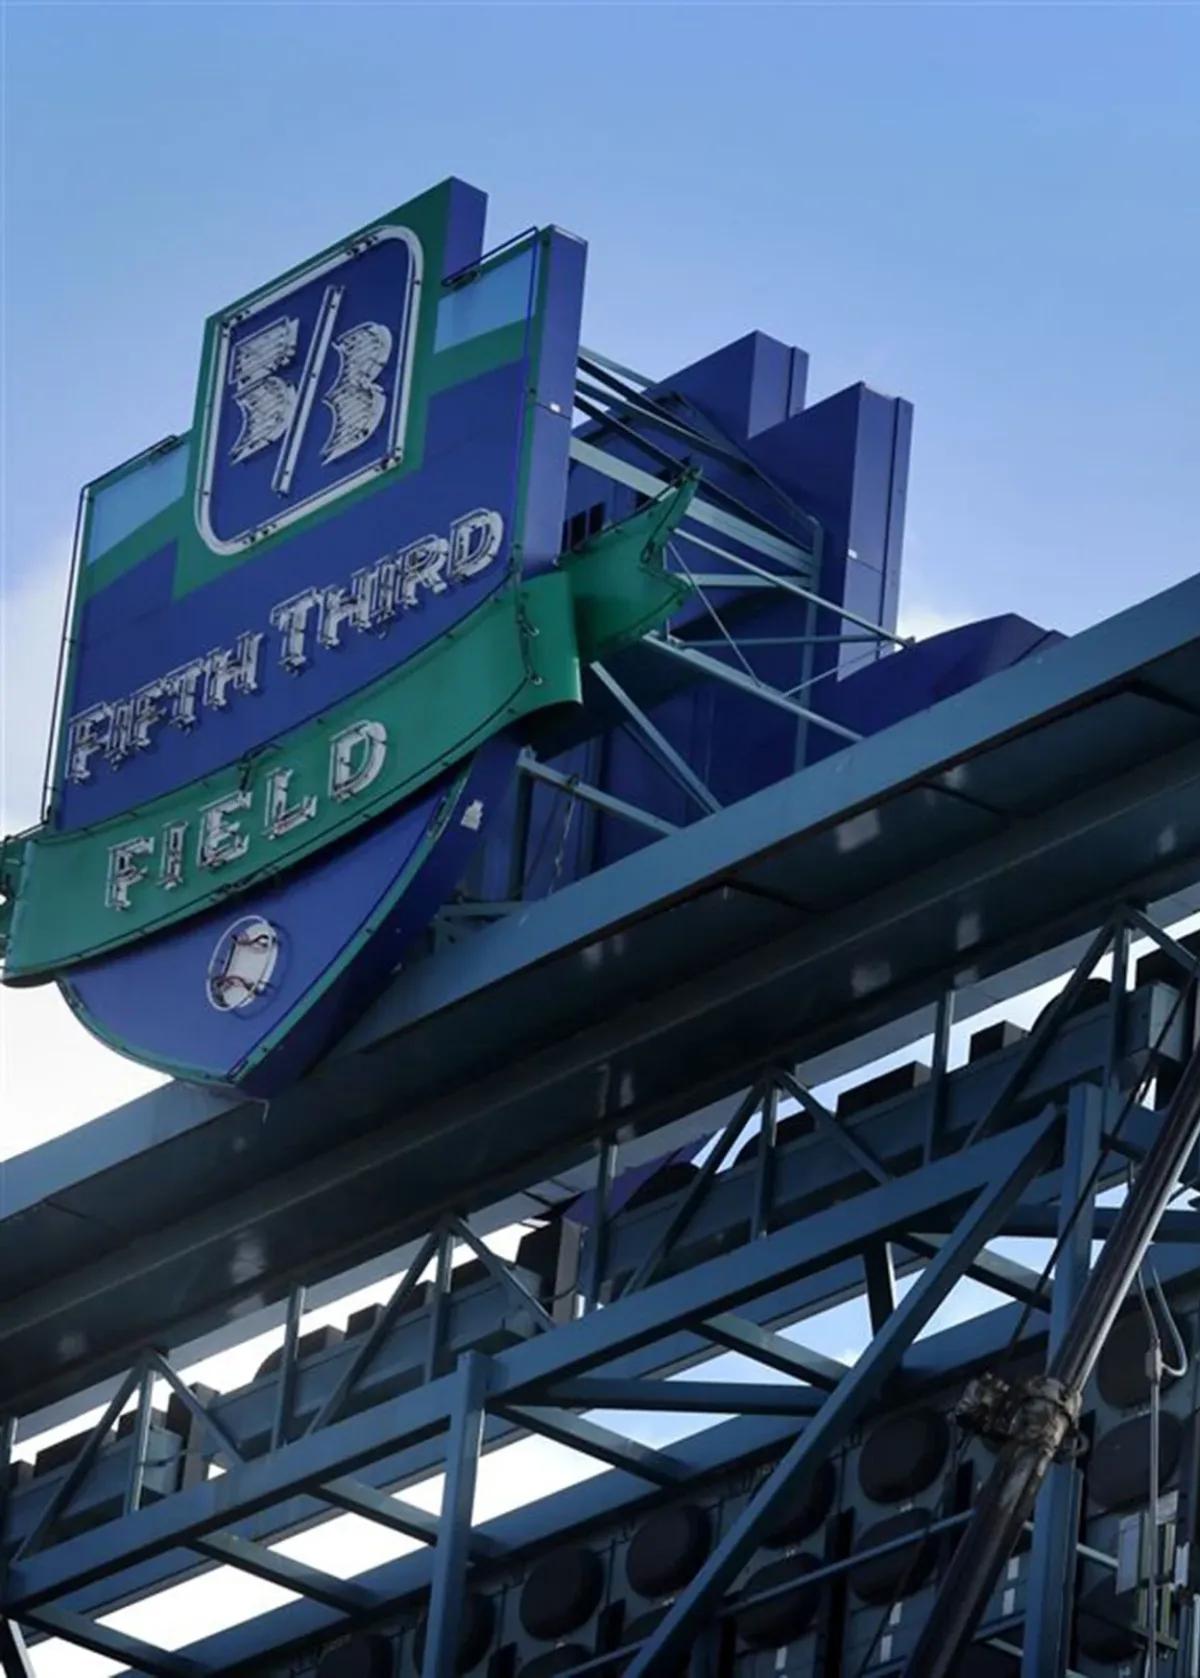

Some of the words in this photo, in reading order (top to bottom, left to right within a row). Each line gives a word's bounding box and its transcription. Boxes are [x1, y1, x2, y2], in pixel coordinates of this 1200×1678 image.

[66, 630, 264, 784] FIFTH
[270, 507, 503, 673] THIRD
[104, 719, 389, 912] FIELD
